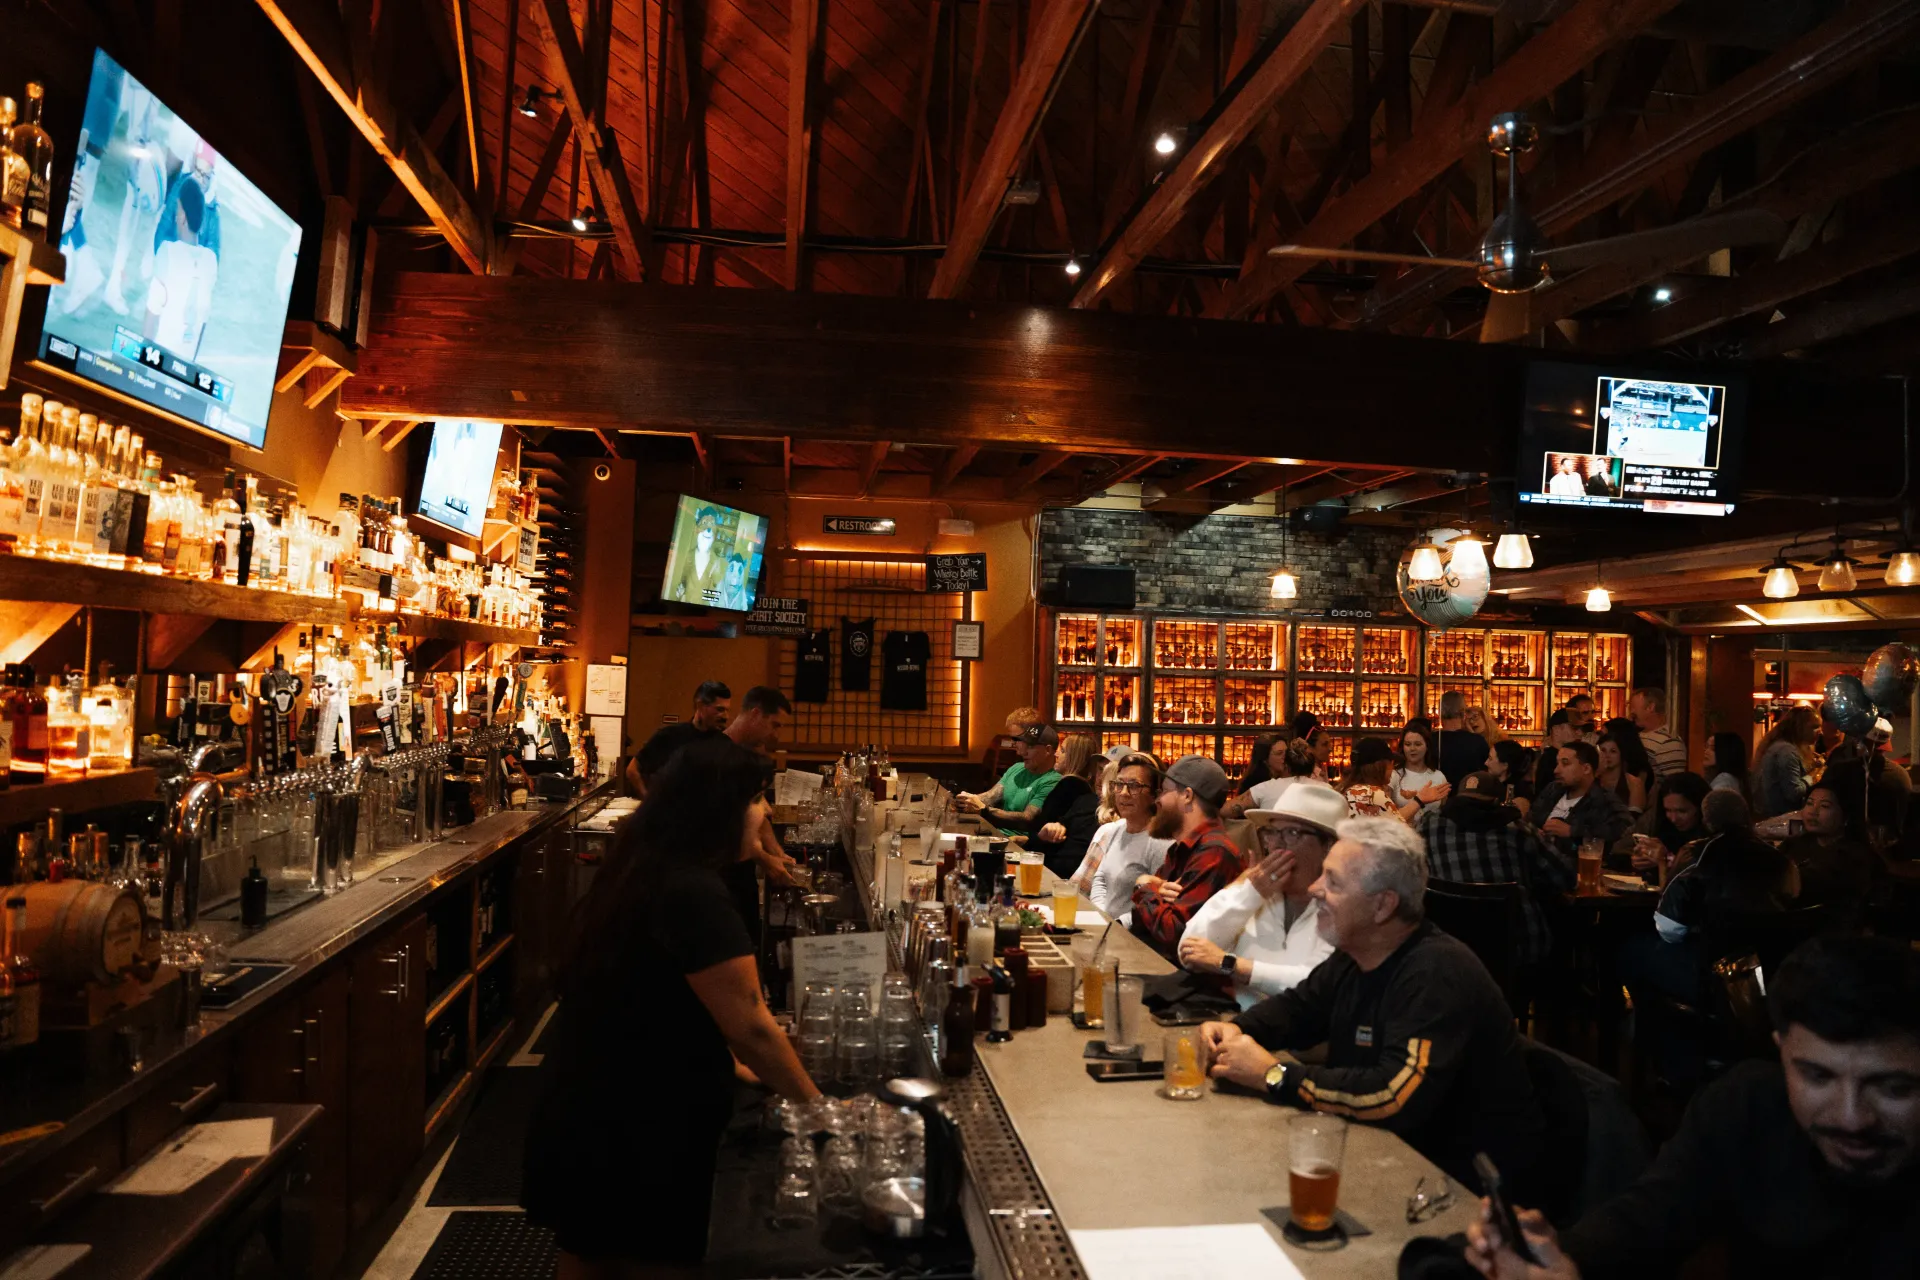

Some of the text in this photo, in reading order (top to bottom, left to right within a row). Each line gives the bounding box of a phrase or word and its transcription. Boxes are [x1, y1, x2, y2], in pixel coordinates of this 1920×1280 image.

[145, 346, 161, 365] 14
[199, 373, 212, 389] 12
[838, 520, 893, 532] RESTROO
[936, 556, 970, 566] Grab Your
[960, 567, 979, 578] Bottle
[944, 580, 970, 591] Today!
[756, 597, 798, 610] JOIN THE
[747, 610, 807, 624] SPIRIT SOCIETY
